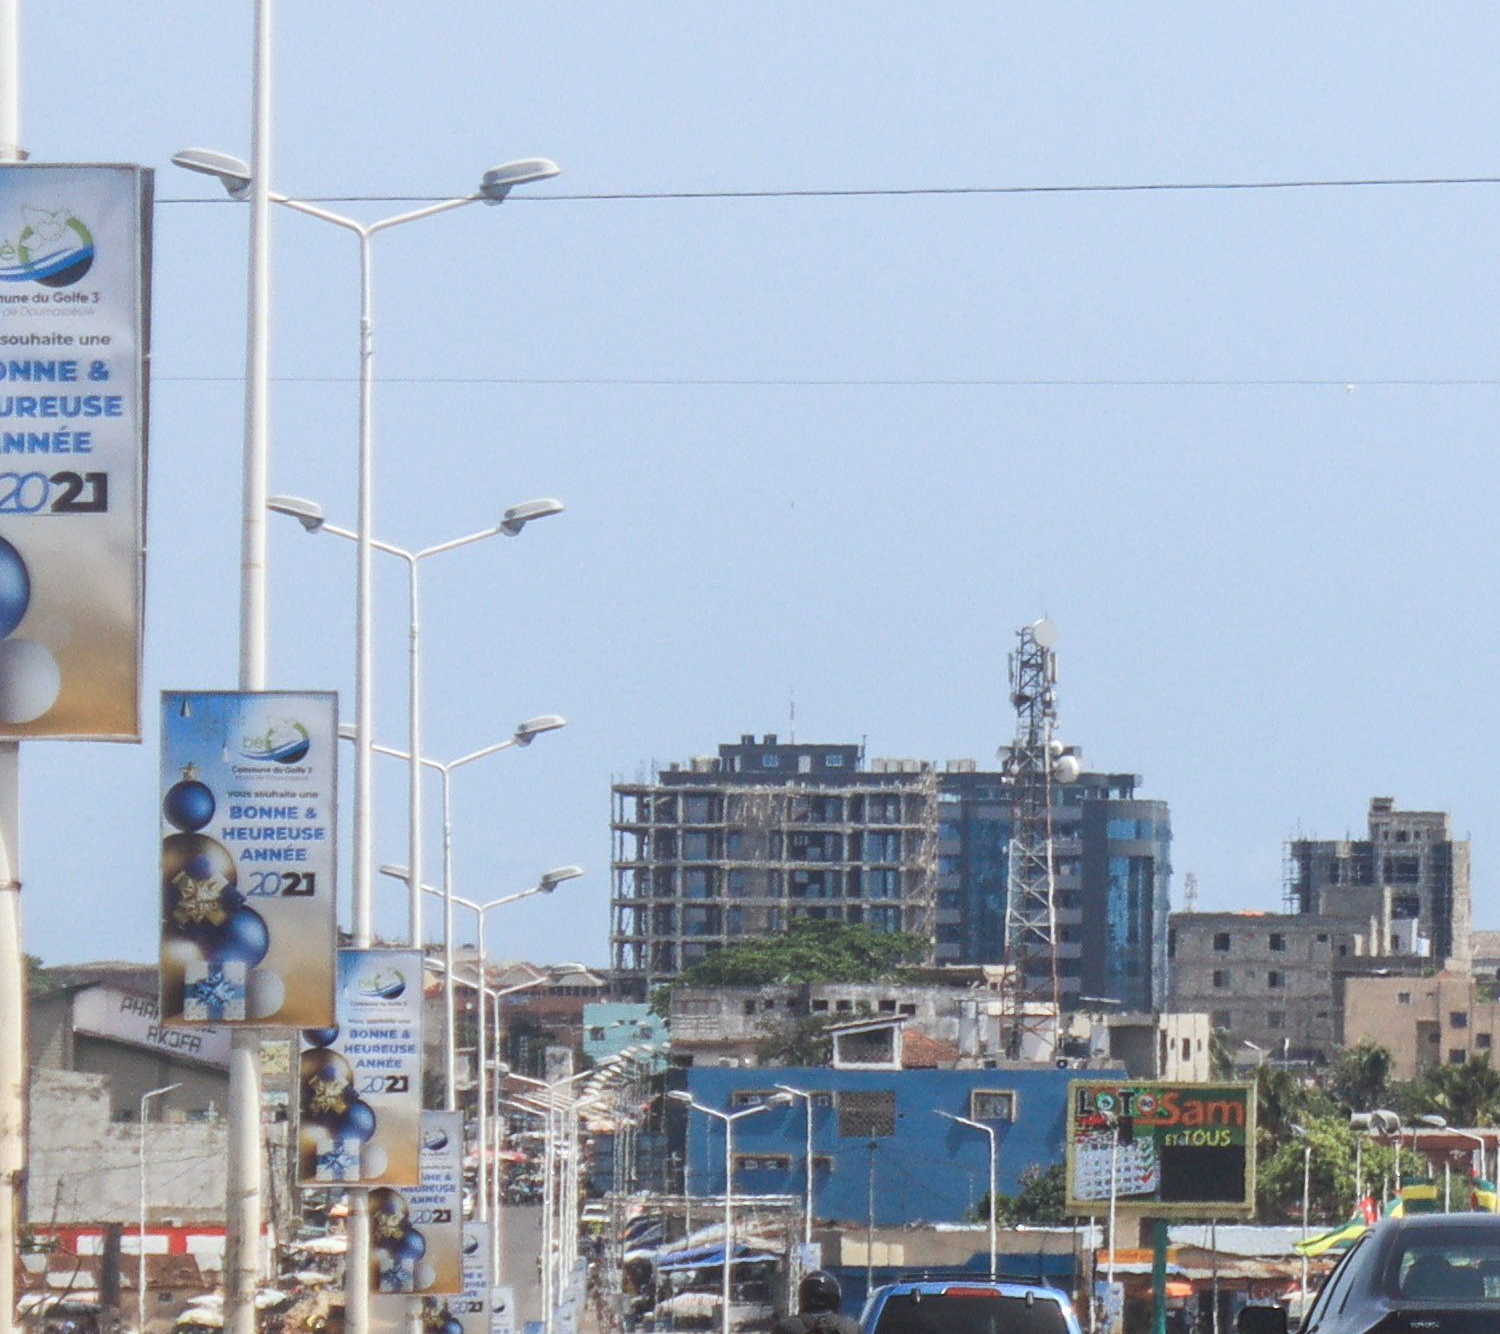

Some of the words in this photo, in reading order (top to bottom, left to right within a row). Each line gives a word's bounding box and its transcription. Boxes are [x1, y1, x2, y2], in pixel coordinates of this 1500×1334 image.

[32, 293, 49, 304] du
[53, 292, 89, 304] Golfe
[91, 292, 100, 304] 3
[0, 333, 74, 347] souhaite
[79, 335, 111, 346] une
[88, 360, 110, 382] &
[0, 425, 92, 454] NNÉE
[227, 791, 251, 799] vous
[254, 789, 297, 799] souhaite
[299, 791, 319, 799] une
[229, 806, 299, 820] BONNE
[304, 806, 317, 819] &
[222, 827, 325, 841] HEUREUSE
[240, 844, 307, 862] ANNÉE
[246, 871, 316, 897] 2021
[349, 1029, 397, 1039] BONNE
[343, 1044, 416, 1054] HEUREUSE
[356, 1056, 402, 1068] ANNÉE
[360, 1075, 409, 1093] 2021
[1160, 1090, 1245, 1127] Sam
[1184, 1130, 1231, 1147] TOUS
